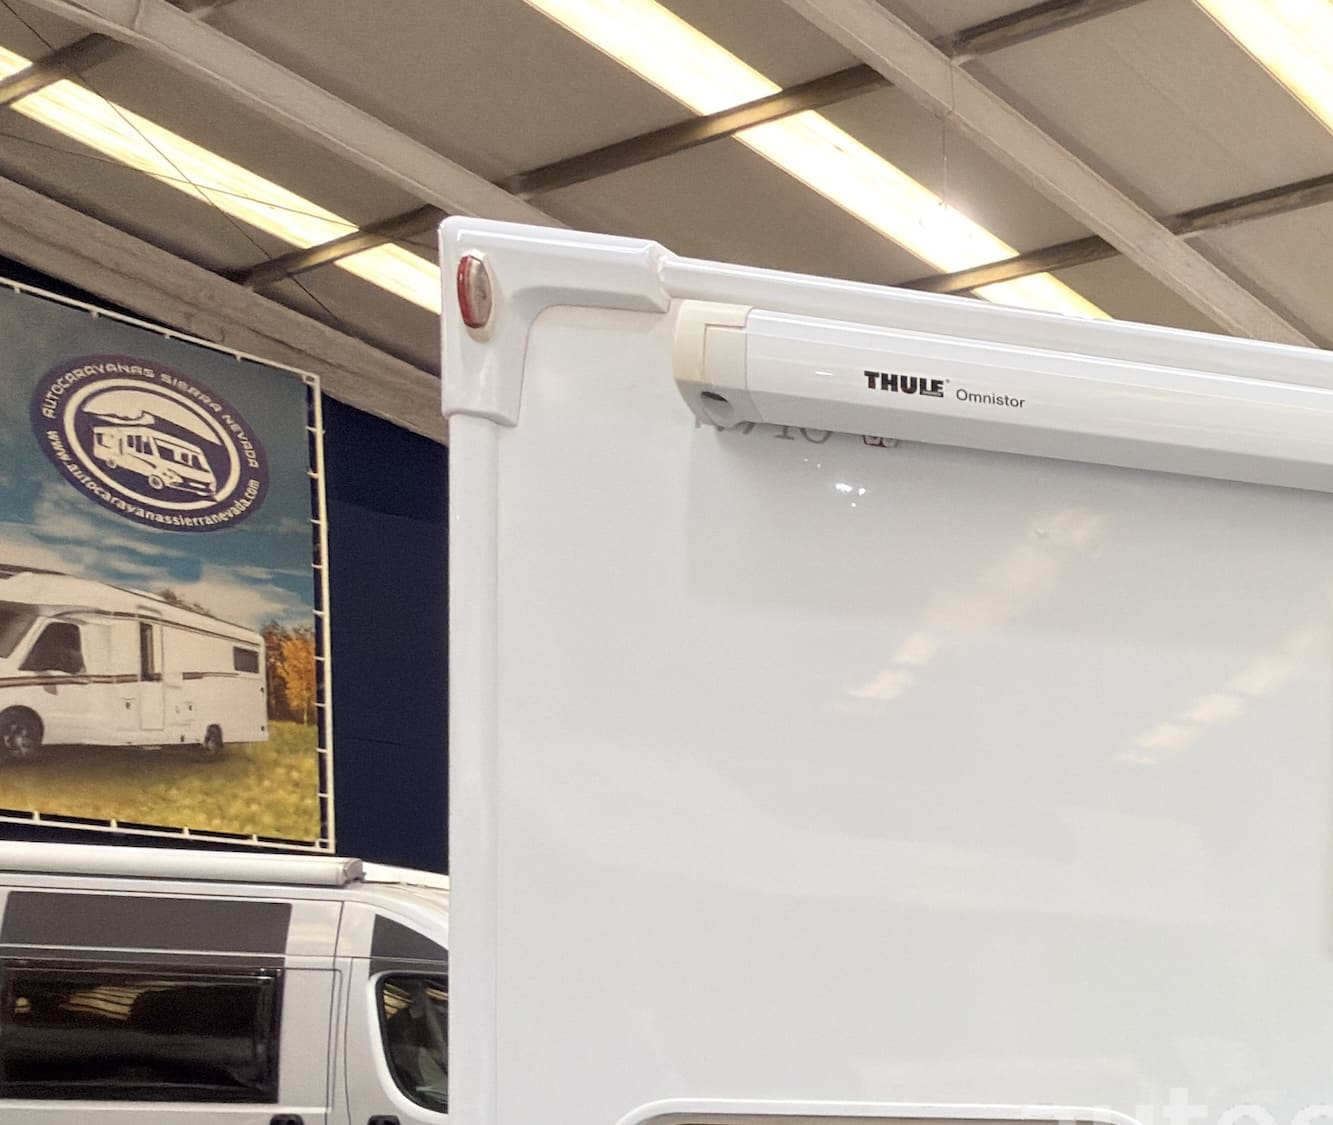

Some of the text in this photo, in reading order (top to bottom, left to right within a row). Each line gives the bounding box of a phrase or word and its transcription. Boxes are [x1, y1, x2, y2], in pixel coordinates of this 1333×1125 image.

[42, 363, 259, 468] AUTOCARAVANAS SIERRA NEVADA
[864, 370, 1025, 408] THULE Omnistor
